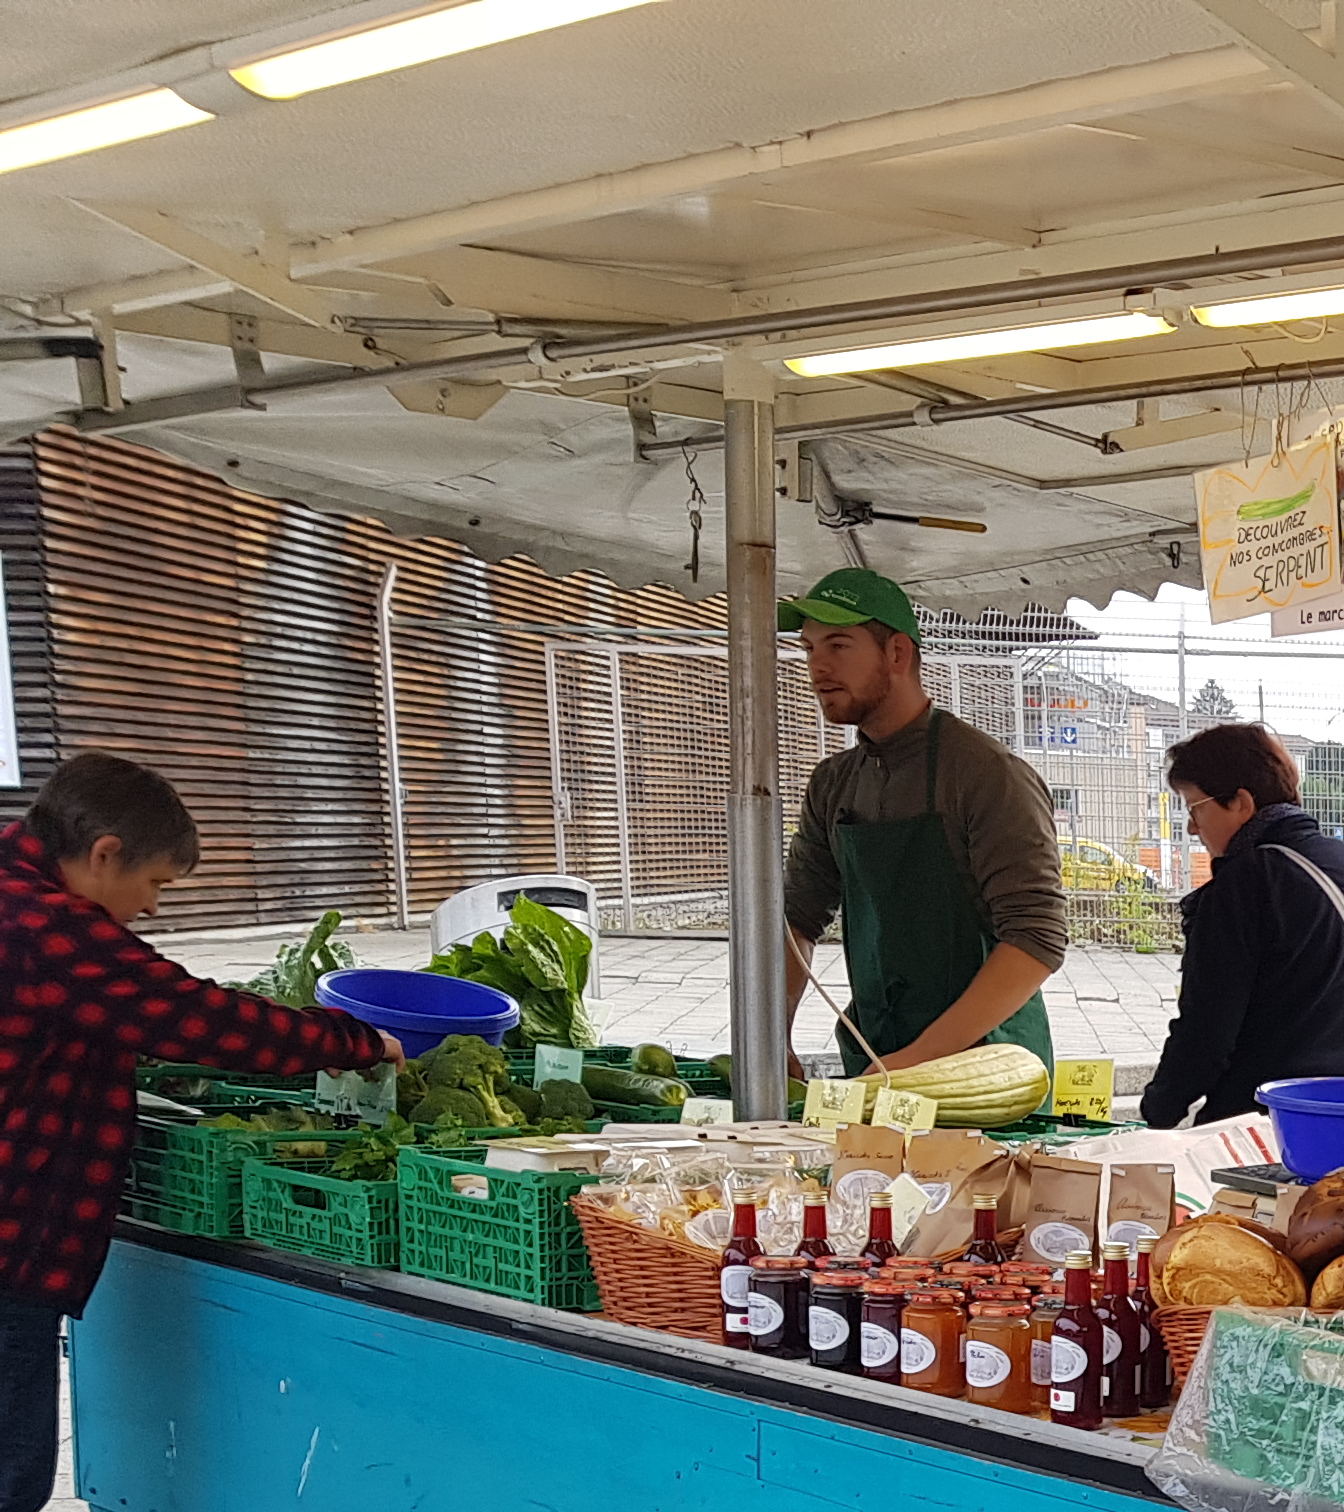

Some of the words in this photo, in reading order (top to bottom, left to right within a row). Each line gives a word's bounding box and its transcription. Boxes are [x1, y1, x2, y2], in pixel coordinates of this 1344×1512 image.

[1237, 510, 1307, 544] DECOUVREZ
[1229, 549, 1252, 567] NOS
[1245, 541, 1329, 602] SERPENT
[1300, 611, 1314, 625] Le
